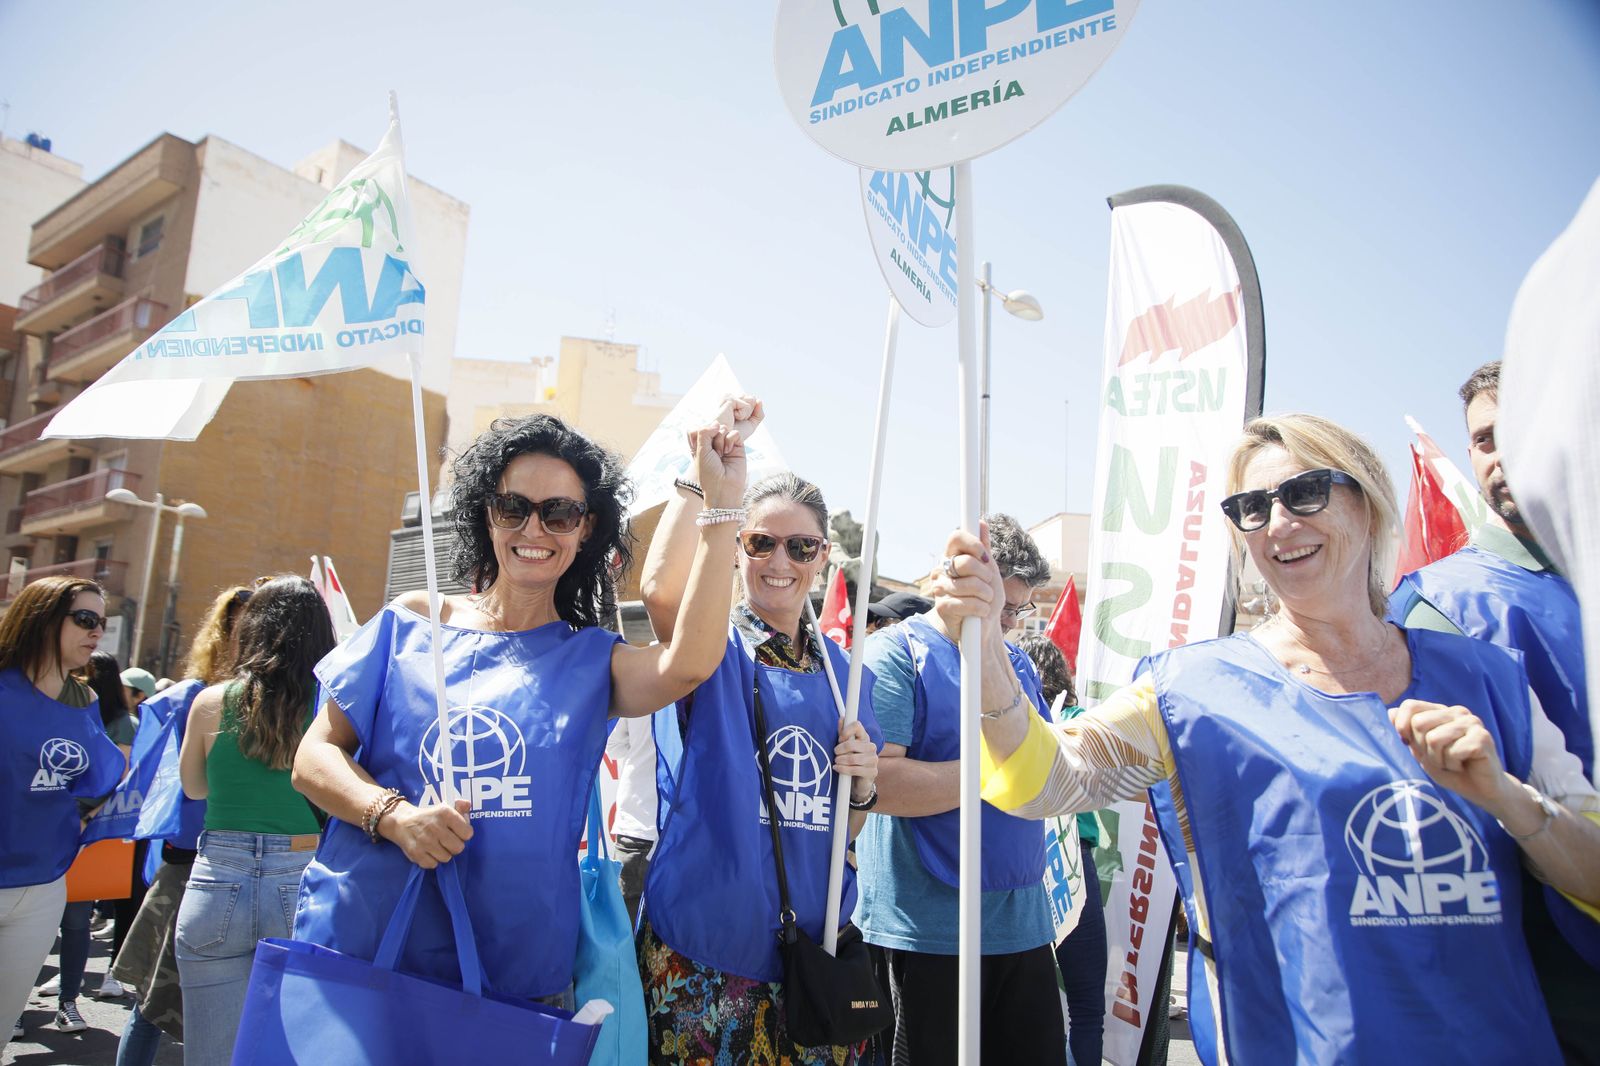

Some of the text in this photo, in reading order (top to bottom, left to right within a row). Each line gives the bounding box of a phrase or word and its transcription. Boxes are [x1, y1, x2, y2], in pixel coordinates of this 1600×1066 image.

[809, 14, 1118, 124] SINDICATO INDEPENDIENTE
[886, 79, 1025, 136] ALMERÍA
[867, 190, 958, 307] SINDICATO INDEPENDIENTE
[890, 247, 932, 304] ALMERÍA
[470, 810, 532, 819] DEPENDIENTE
[1350, 871, 1502, 916] ANPE
